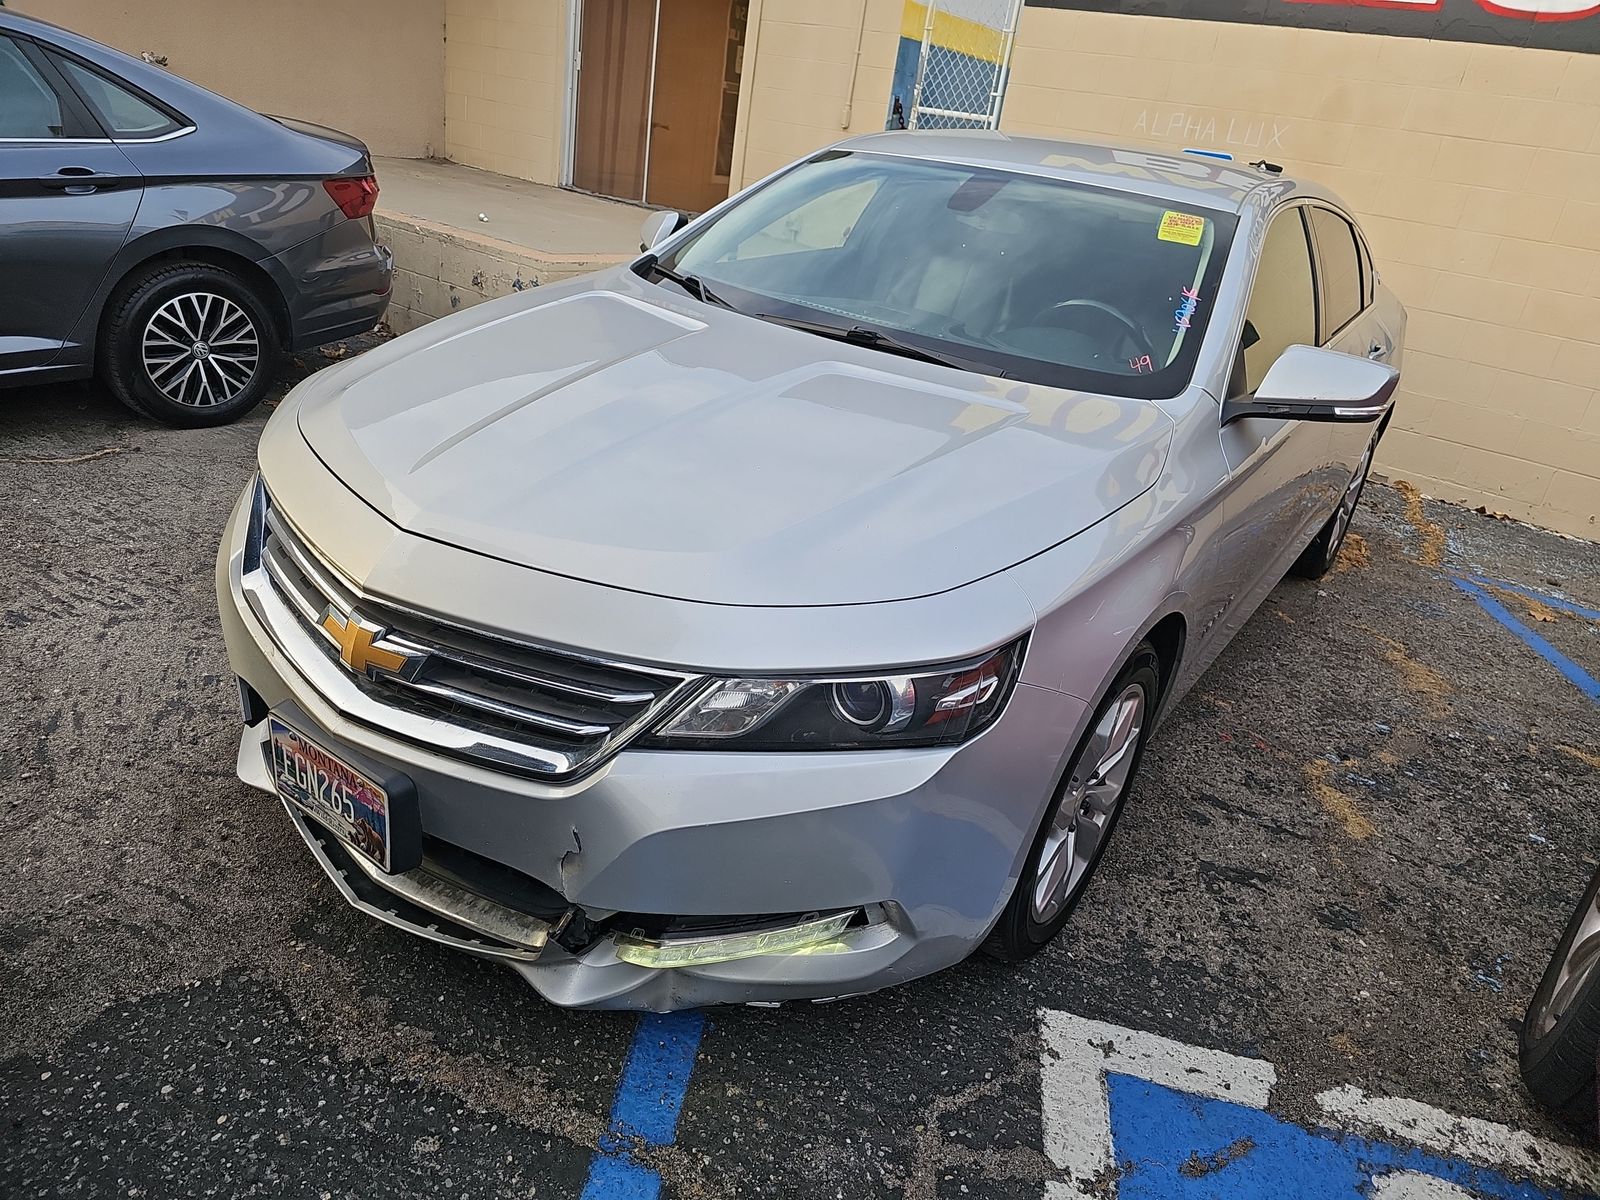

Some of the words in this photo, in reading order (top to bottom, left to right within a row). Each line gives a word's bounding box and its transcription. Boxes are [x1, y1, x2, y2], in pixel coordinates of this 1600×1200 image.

[1133, 109, 1215, 143] ALPHA
[1226, 117, 1291, 150] LUX
[1129, 354, 1154, 374] 49
[281, 745, 355, 824] EGN265
[299, 740, 356, 786] MONTANA
